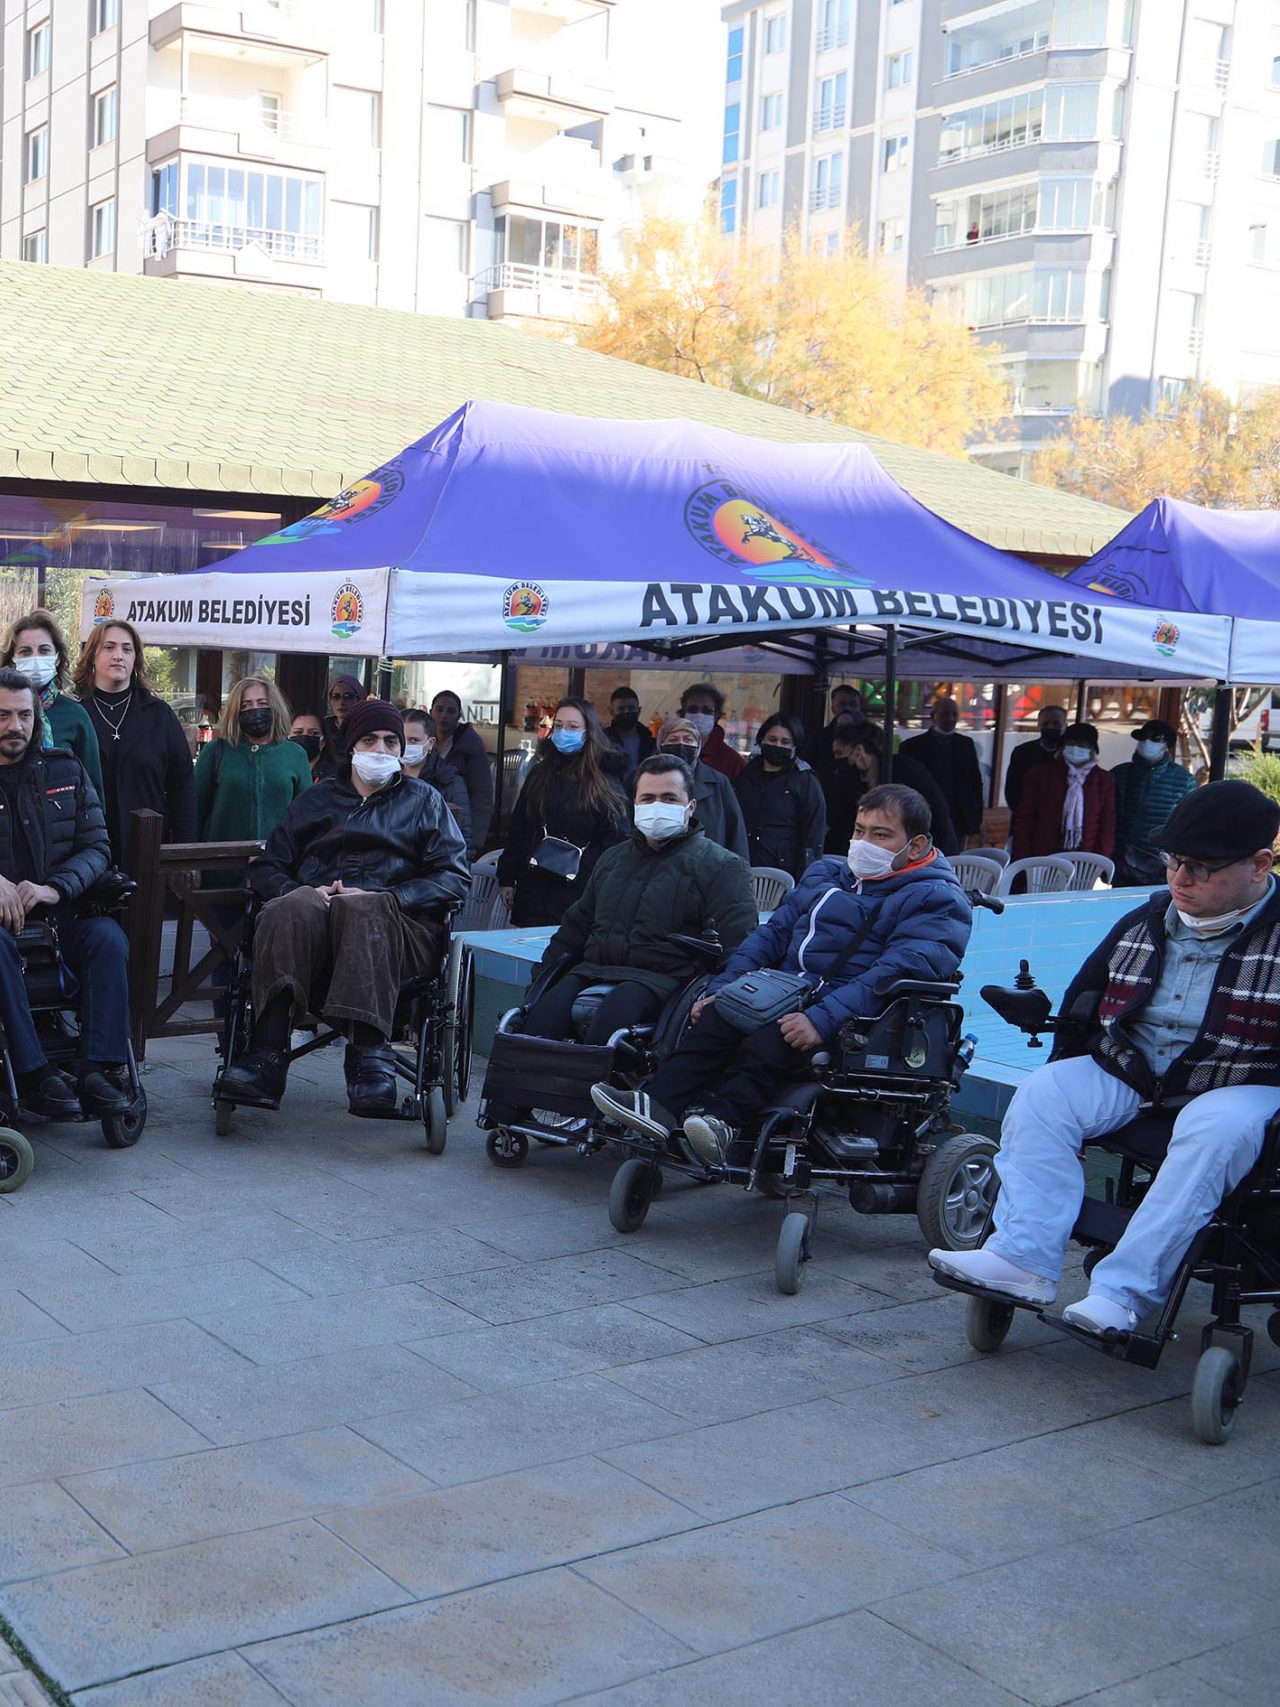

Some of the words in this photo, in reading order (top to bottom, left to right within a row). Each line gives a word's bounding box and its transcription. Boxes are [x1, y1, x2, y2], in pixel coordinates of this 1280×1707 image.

[126, 600, 193, 623] ATAKUM
[198, 594, 311, 626] BELEDİYESİ
[640, 583, 858, 628] ATAKUM
